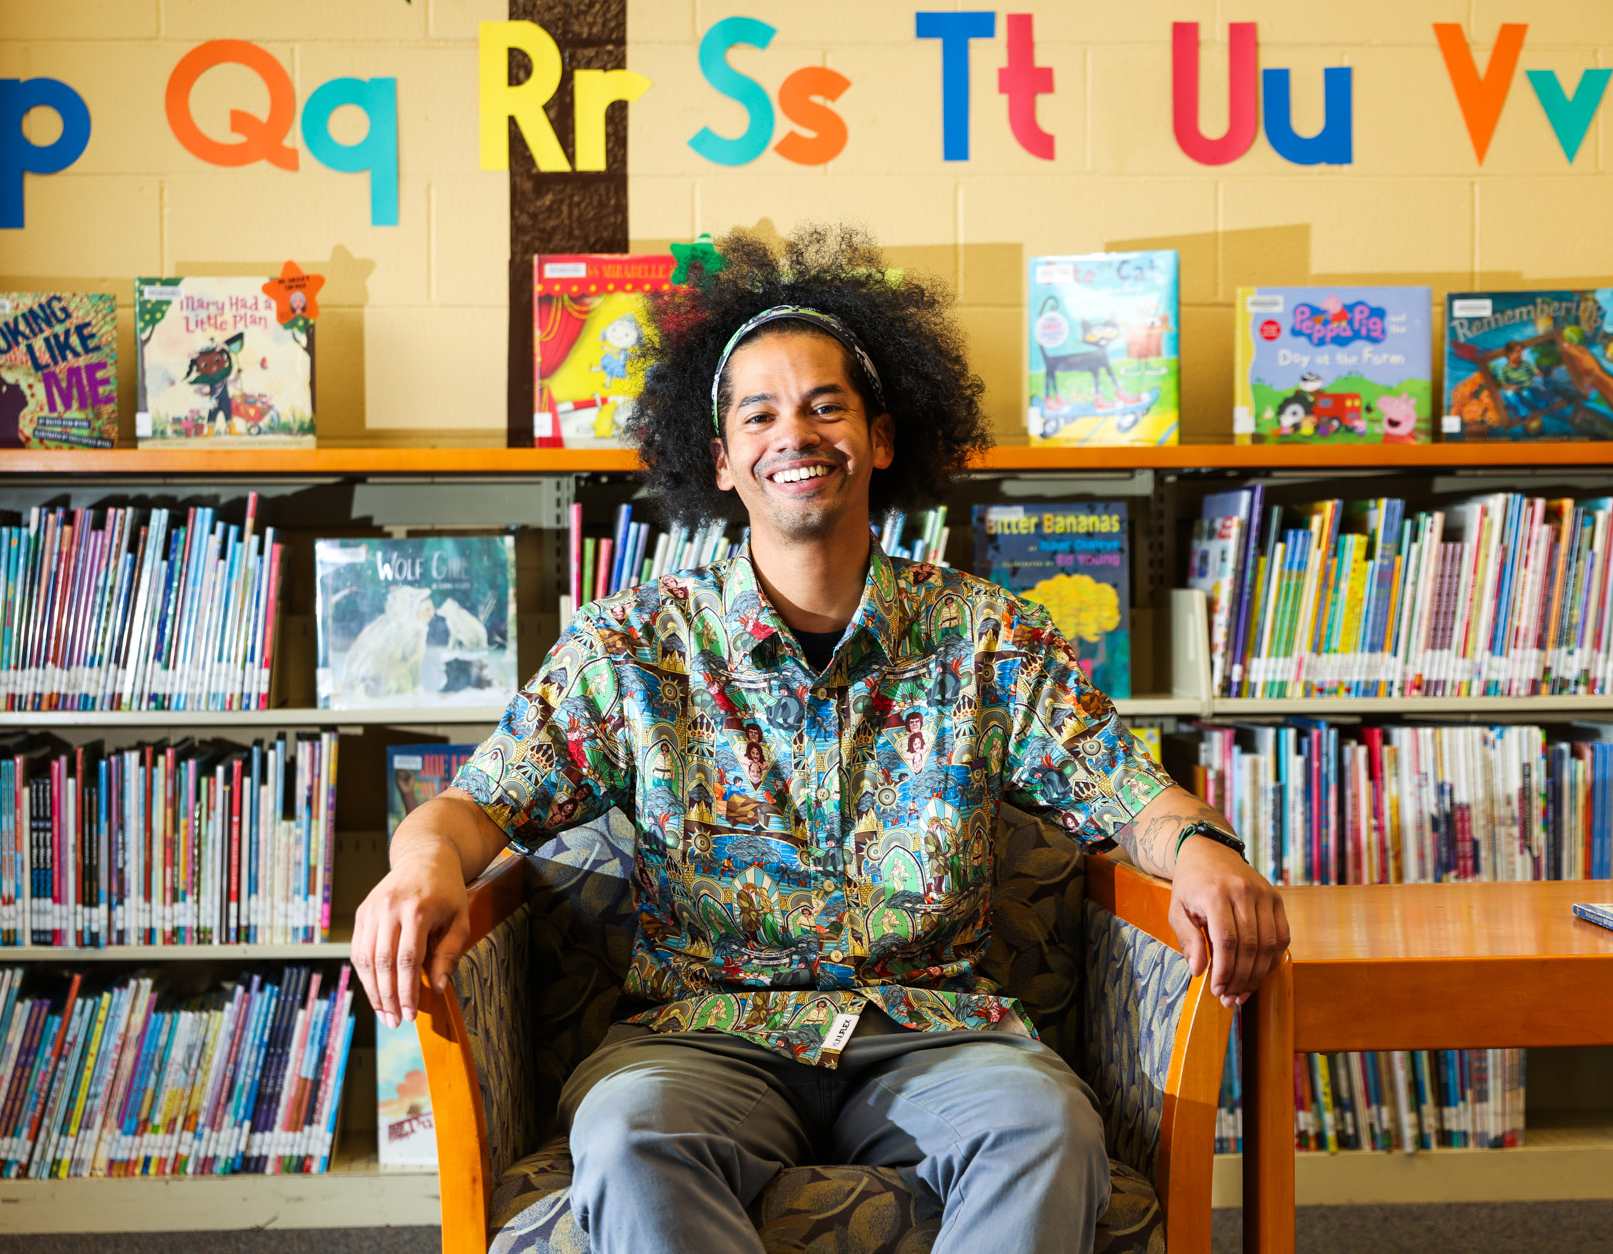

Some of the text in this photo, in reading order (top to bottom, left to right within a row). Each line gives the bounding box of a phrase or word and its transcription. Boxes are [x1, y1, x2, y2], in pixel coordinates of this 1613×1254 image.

[165, 38, 399, 226] Qq
[479, 20, 655, 172] Rr
[687, 16, 852, 167] Ss
[915, 11, 1056, 162] Tt
[1172, 21, 1353, 166] Uu
[1432, 22, 1613, 167] Vv
[601, 263, 666, 279] MIRABELLE
[1116, 259, 1157, 281] Cat
[179, 295, 274, 316] Mary Had a
[184, 312, 268, 333] Little Plan
[1295, 304, 1386, 344] Peppa Pig
[1450, 296, 1606, 344] Remembering
[25, 321, 103, 373] LIKE
[1278, 347, 1406, 368] Day at the Farm
[41, 360, 116, 414] ME
[1042, 513, 1120, 533] Bananas
[1056, 554, 1074, 567] Ed
[1077, 554, 1121, 568] Young
[419, 754, 448, 778] JOE
